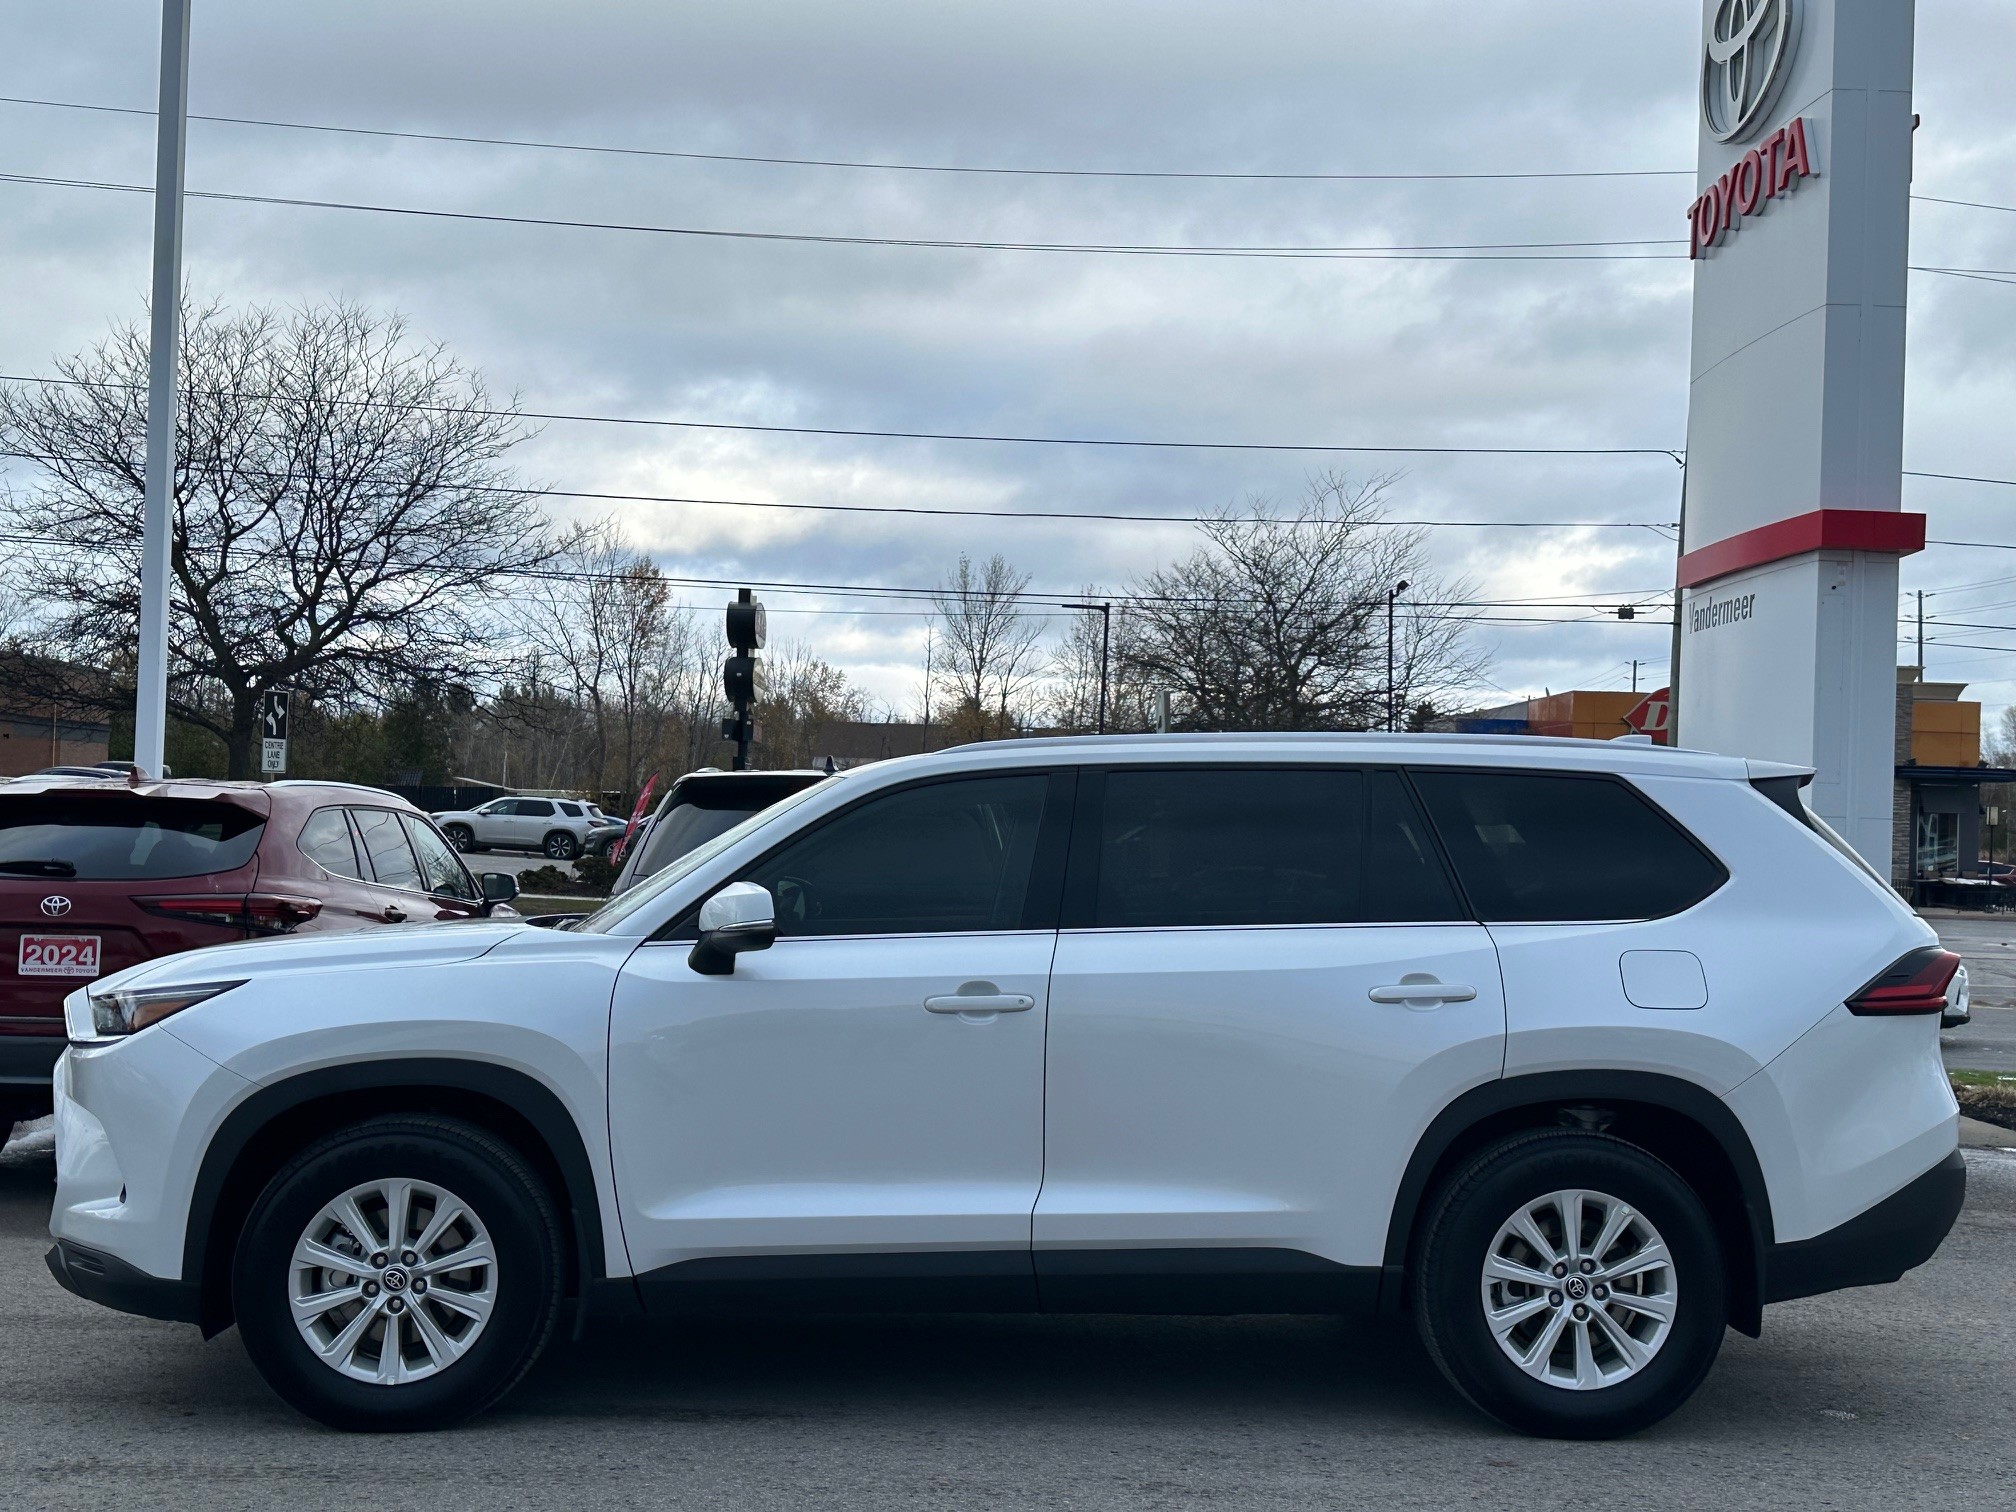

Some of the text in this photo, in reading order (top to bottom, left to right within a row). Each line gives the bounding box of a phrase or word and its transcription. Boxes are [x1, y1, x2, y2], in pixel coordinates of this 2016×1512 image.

[1687, 117, 1812, 260] TOYOTA
[1688, 593, 1756, 634] Vandermeer
[264, 741, 284, 750] CENTRE
[267, 751, 280, 759] LANE
[267, 760, 279, 769] ONLY
[24, 944, 94, 966] 2024
